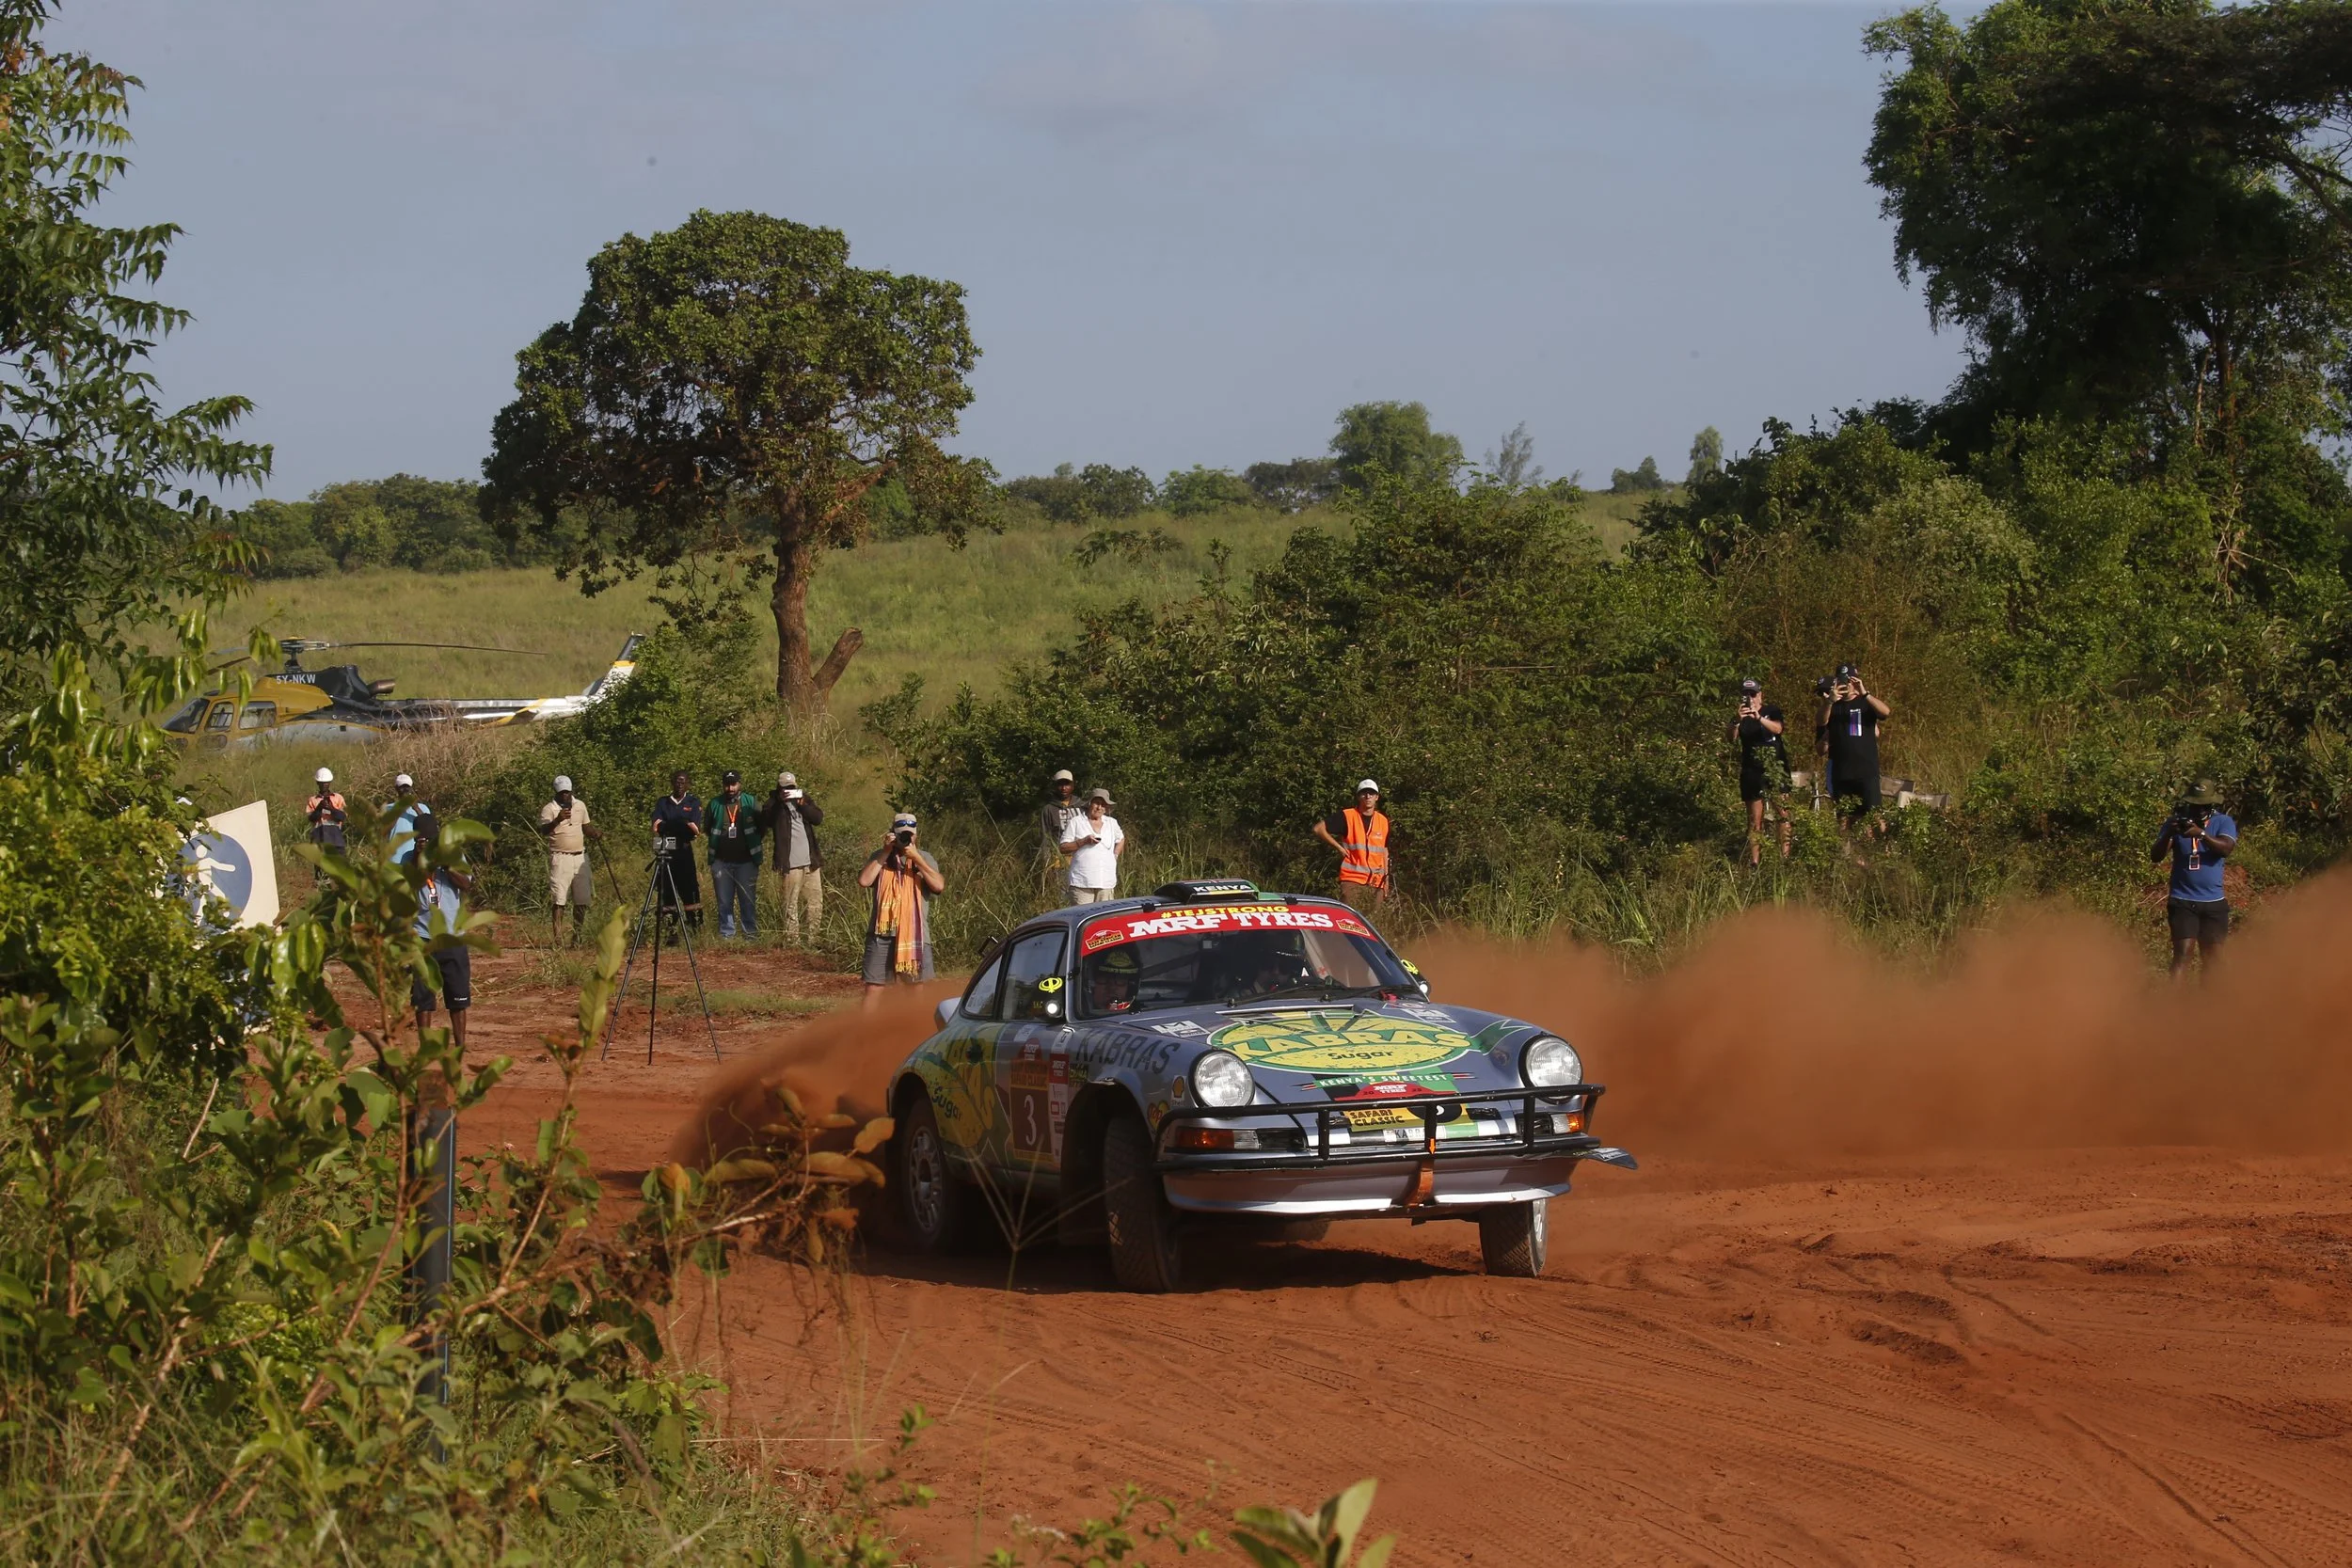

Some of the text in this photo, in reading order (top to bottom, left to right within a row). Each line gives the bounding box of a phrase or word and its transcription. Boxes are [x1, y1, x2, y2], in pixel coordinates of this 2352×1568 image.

[276, 673, 316, 685] 5Y-NKW
[1193, 884, 1252, 893] KENYA
[1161, 906, 1290, 919] #TEJSTRONG
[1127, 913, 1229, 938] MRF
[1230, 912, 1334, 928] TYRES
[1075, 1028, 1181, 1074] KABRAS
[1231, 1030, 1471, 1061] KABRAS
[1327, 1050, 1393, 1060] Sugar
[1320, 1073, 1448, 1086] KENYA'S SWEETEST
[1024, 1094, 1037, 1146] 3
[1350, 1108, 1393, 1119] SAFARI
[1354, 1116, 1406, 1127] CLASSIC
